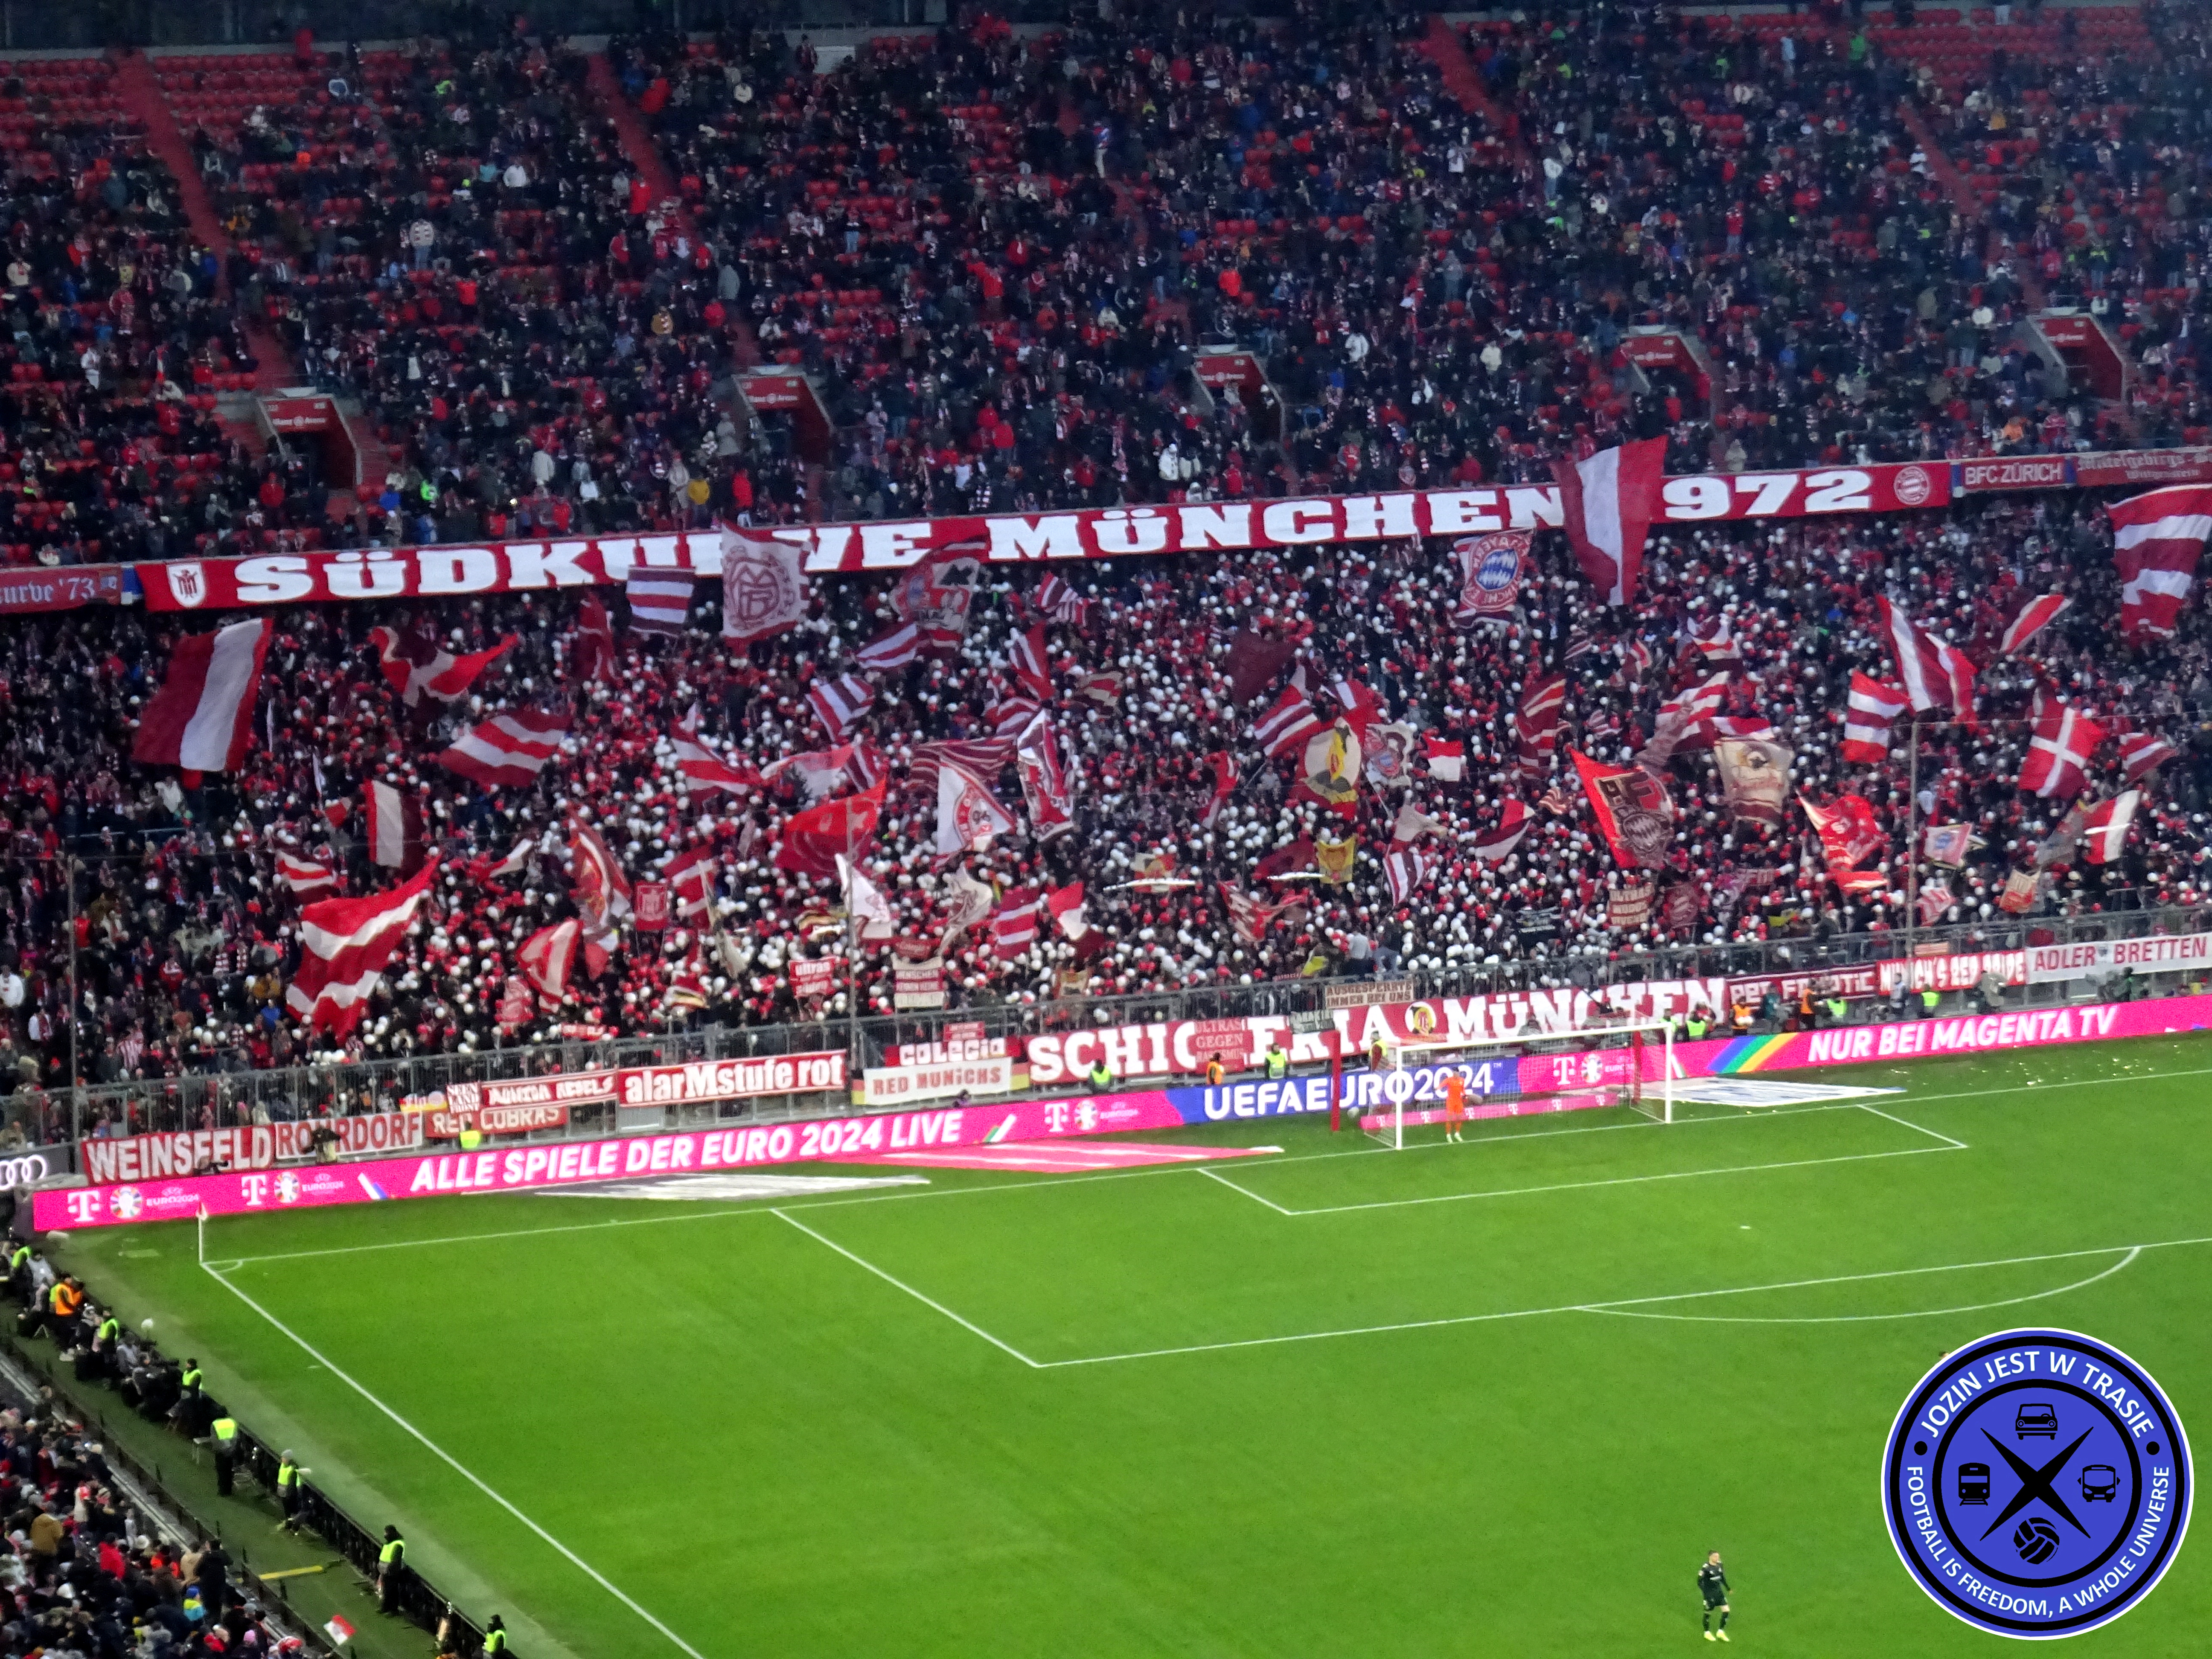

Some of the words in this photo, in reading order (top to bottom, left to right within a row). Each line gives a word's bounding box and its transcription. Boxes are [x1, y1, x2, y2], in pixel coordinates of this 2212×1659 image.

[1965, 466, 1997, 485] BFC
[2000, 462, 2063, 483] ZÜRICH
[985, 487, 1565, 560] MÜNCHEN
[59, 577, 96, 600] '73
[2034, 945, 2096, 972] ADLER
[2113, 936, 2206, 964] BRETTEN
[1951, 956, 1979, 985] RED
[1327, 982, 1412, 996] AUSGESPERRTE
[1327, 994, 1363, 1007] IMMER
[1367, 992, 1386, 1004] BEI
[1389, 991, 1412, 1002] UNS
[1195, 1019, 1242, 1033] ULTRAS
[1196, 1033, 1244, 1048] GEGEN
[1808, 1025, 1874, 1062] NUR
[1878, 1021, 1925, 1056] BEI
[1931, 1008, 2077, 1051] MAGENTA
[2079, 1005, 2120, 1036] TV
[1027, 1004, 1401, 1082] SCHICERIA
[797, 1056, 844, 1086] rot
[873, 1076, 909, 1095] RED
[278, 1112, 420, 1155] RORDORF
[87, 1127, 271, 1184] WEINSFELD
[410, 1153, 497, 1192] ALLE
[503, 1142, 620, 1184] SPIELE
[625, 1135, 694, 1173] DER
[701, 1126, 794, 1166] EURO
[799, 1117, 883, 1156] 2024
[890, 1110, 964, 1148] LIVE
[146, 1194, 200, 1206] EURO2024
